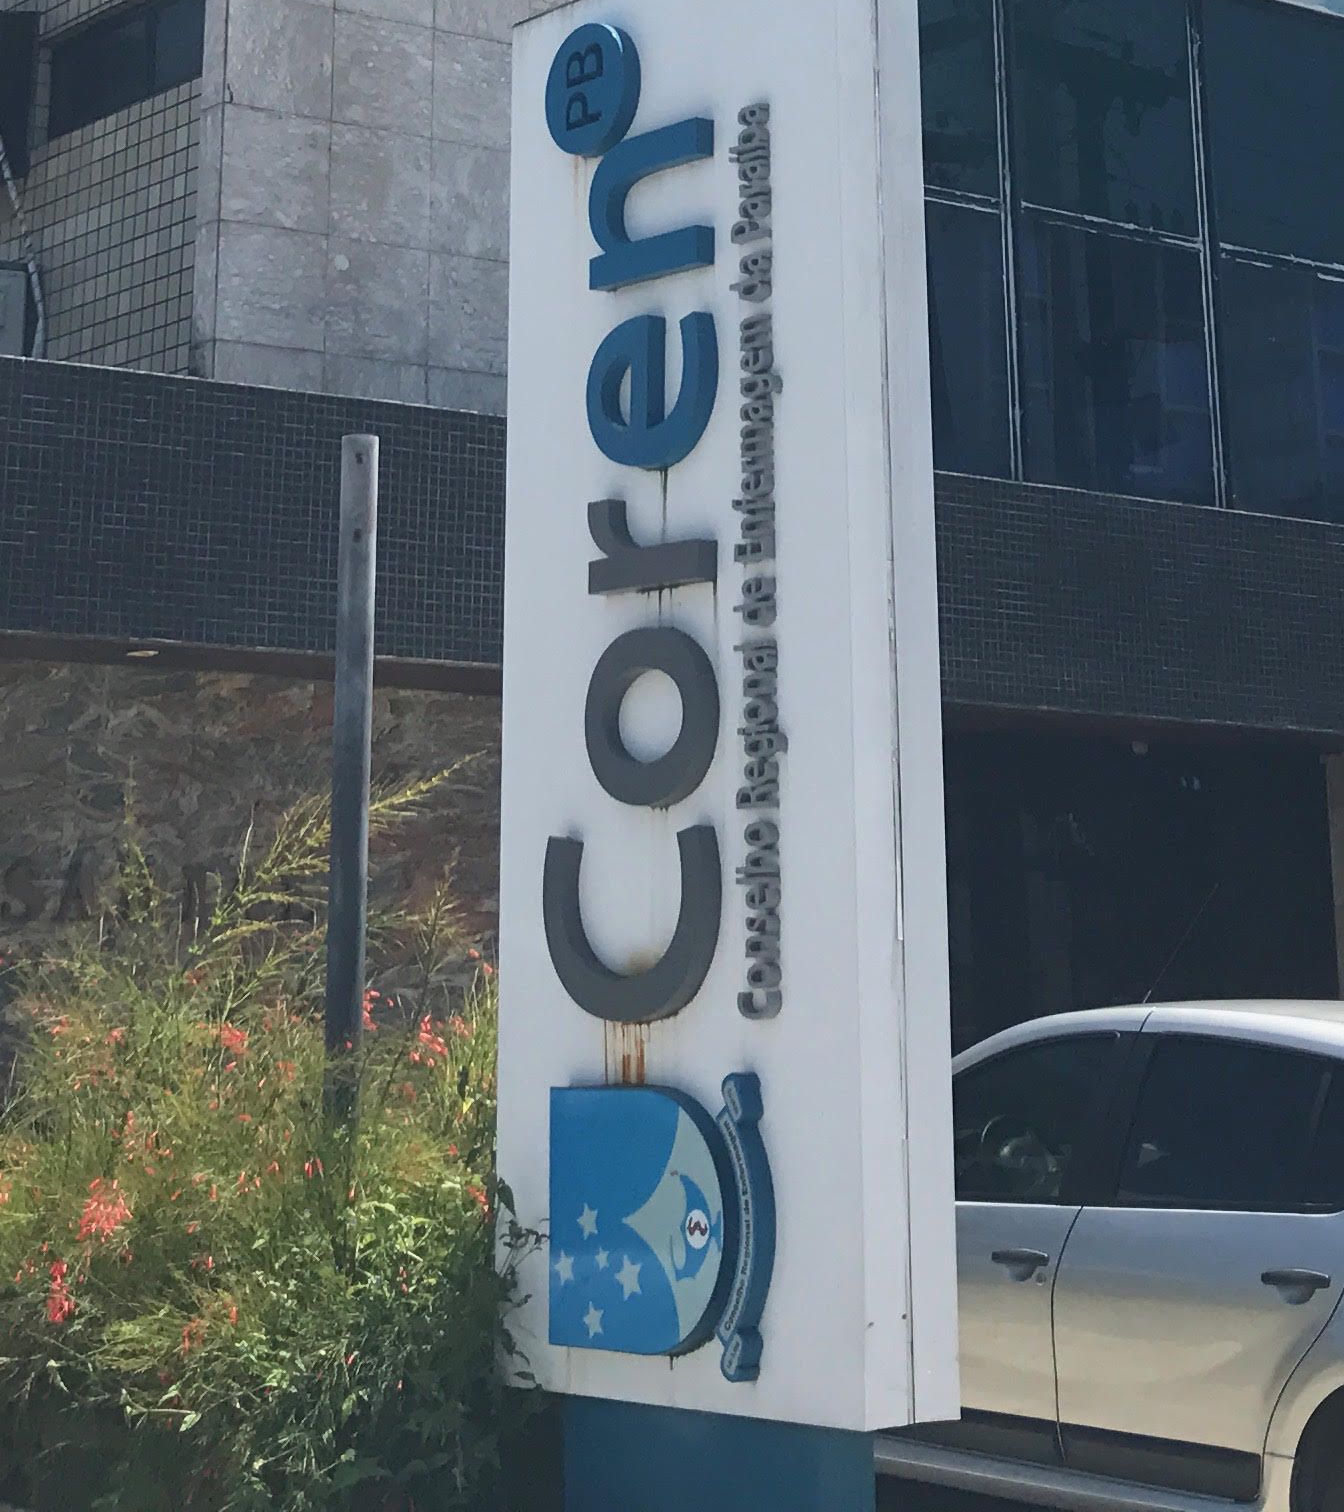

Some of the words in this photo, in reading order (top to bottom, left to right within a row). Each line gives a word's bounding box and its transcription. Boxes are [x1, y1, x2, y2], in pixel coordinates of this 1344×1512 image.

[565, 40, 605, 133] PB
[729, 250, 773, 303] da
[731, 314, 784, 564] Enfermagem
[542, 116, 722, 1024] Coren
[733, 577, 777, 627] de
[733, 638, 789, 809] Regional
[736, 819, 783, 1020] Conselho
